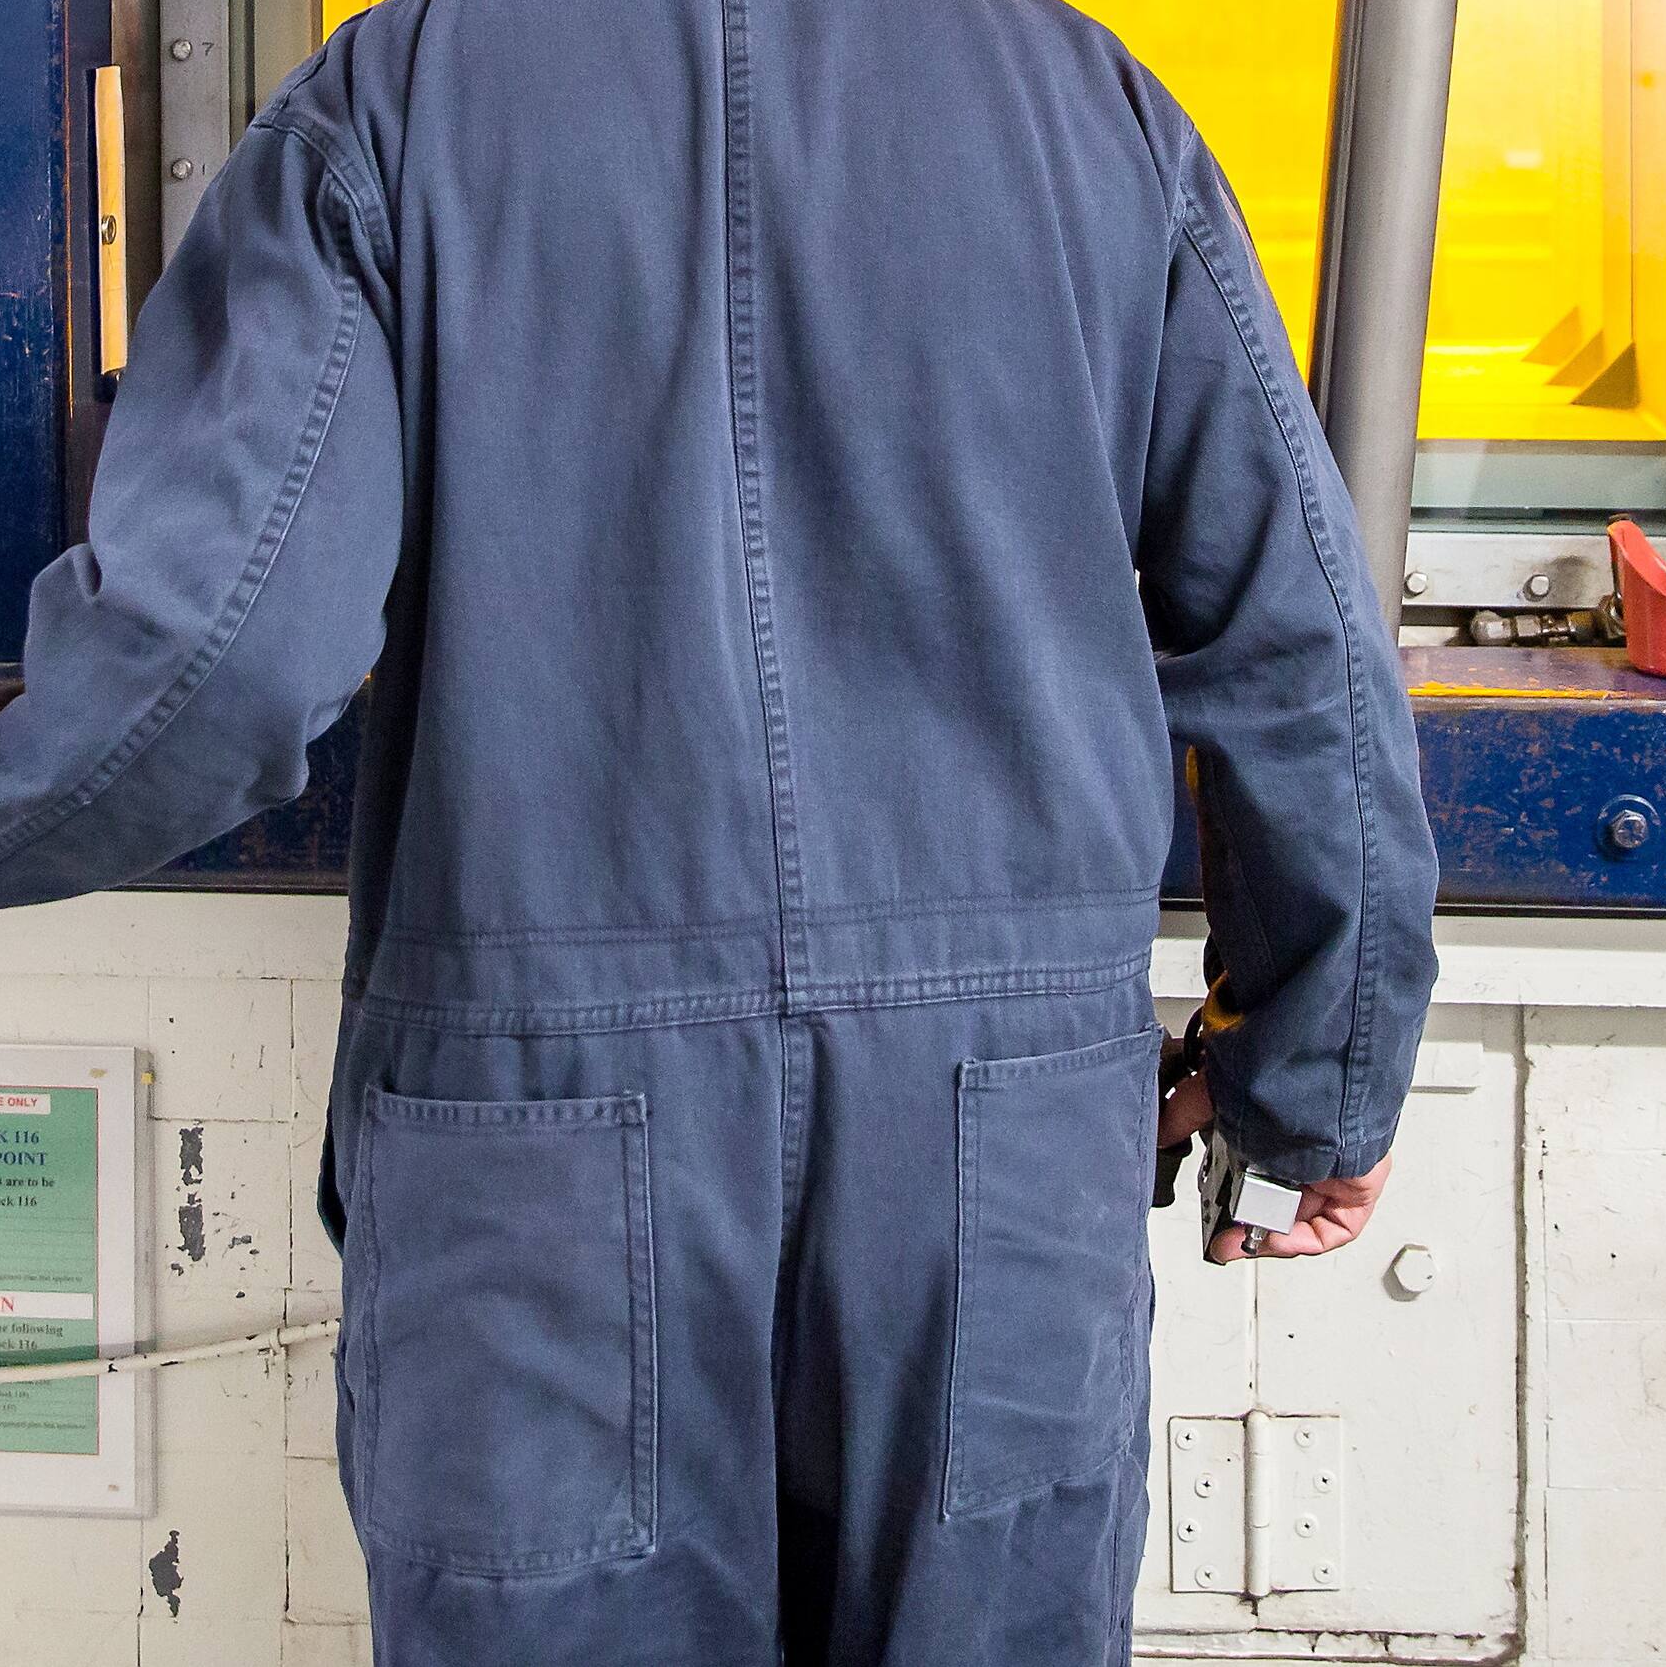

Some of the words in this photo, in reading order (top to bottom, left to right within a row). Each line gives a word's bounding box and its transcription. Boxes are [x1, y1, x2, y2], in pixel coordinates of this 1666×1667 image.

[7, 1097, 37, 1108] ONLY
[15, 1129, 40, 1145] 116
[6, 1178, 25, 1187] are
[27, 1176, 38, 1187] to
[41, 1176, 54, 1187] be
[18, 1196, 37, 1207] 116
[11, 1323, 63, 1337] following
